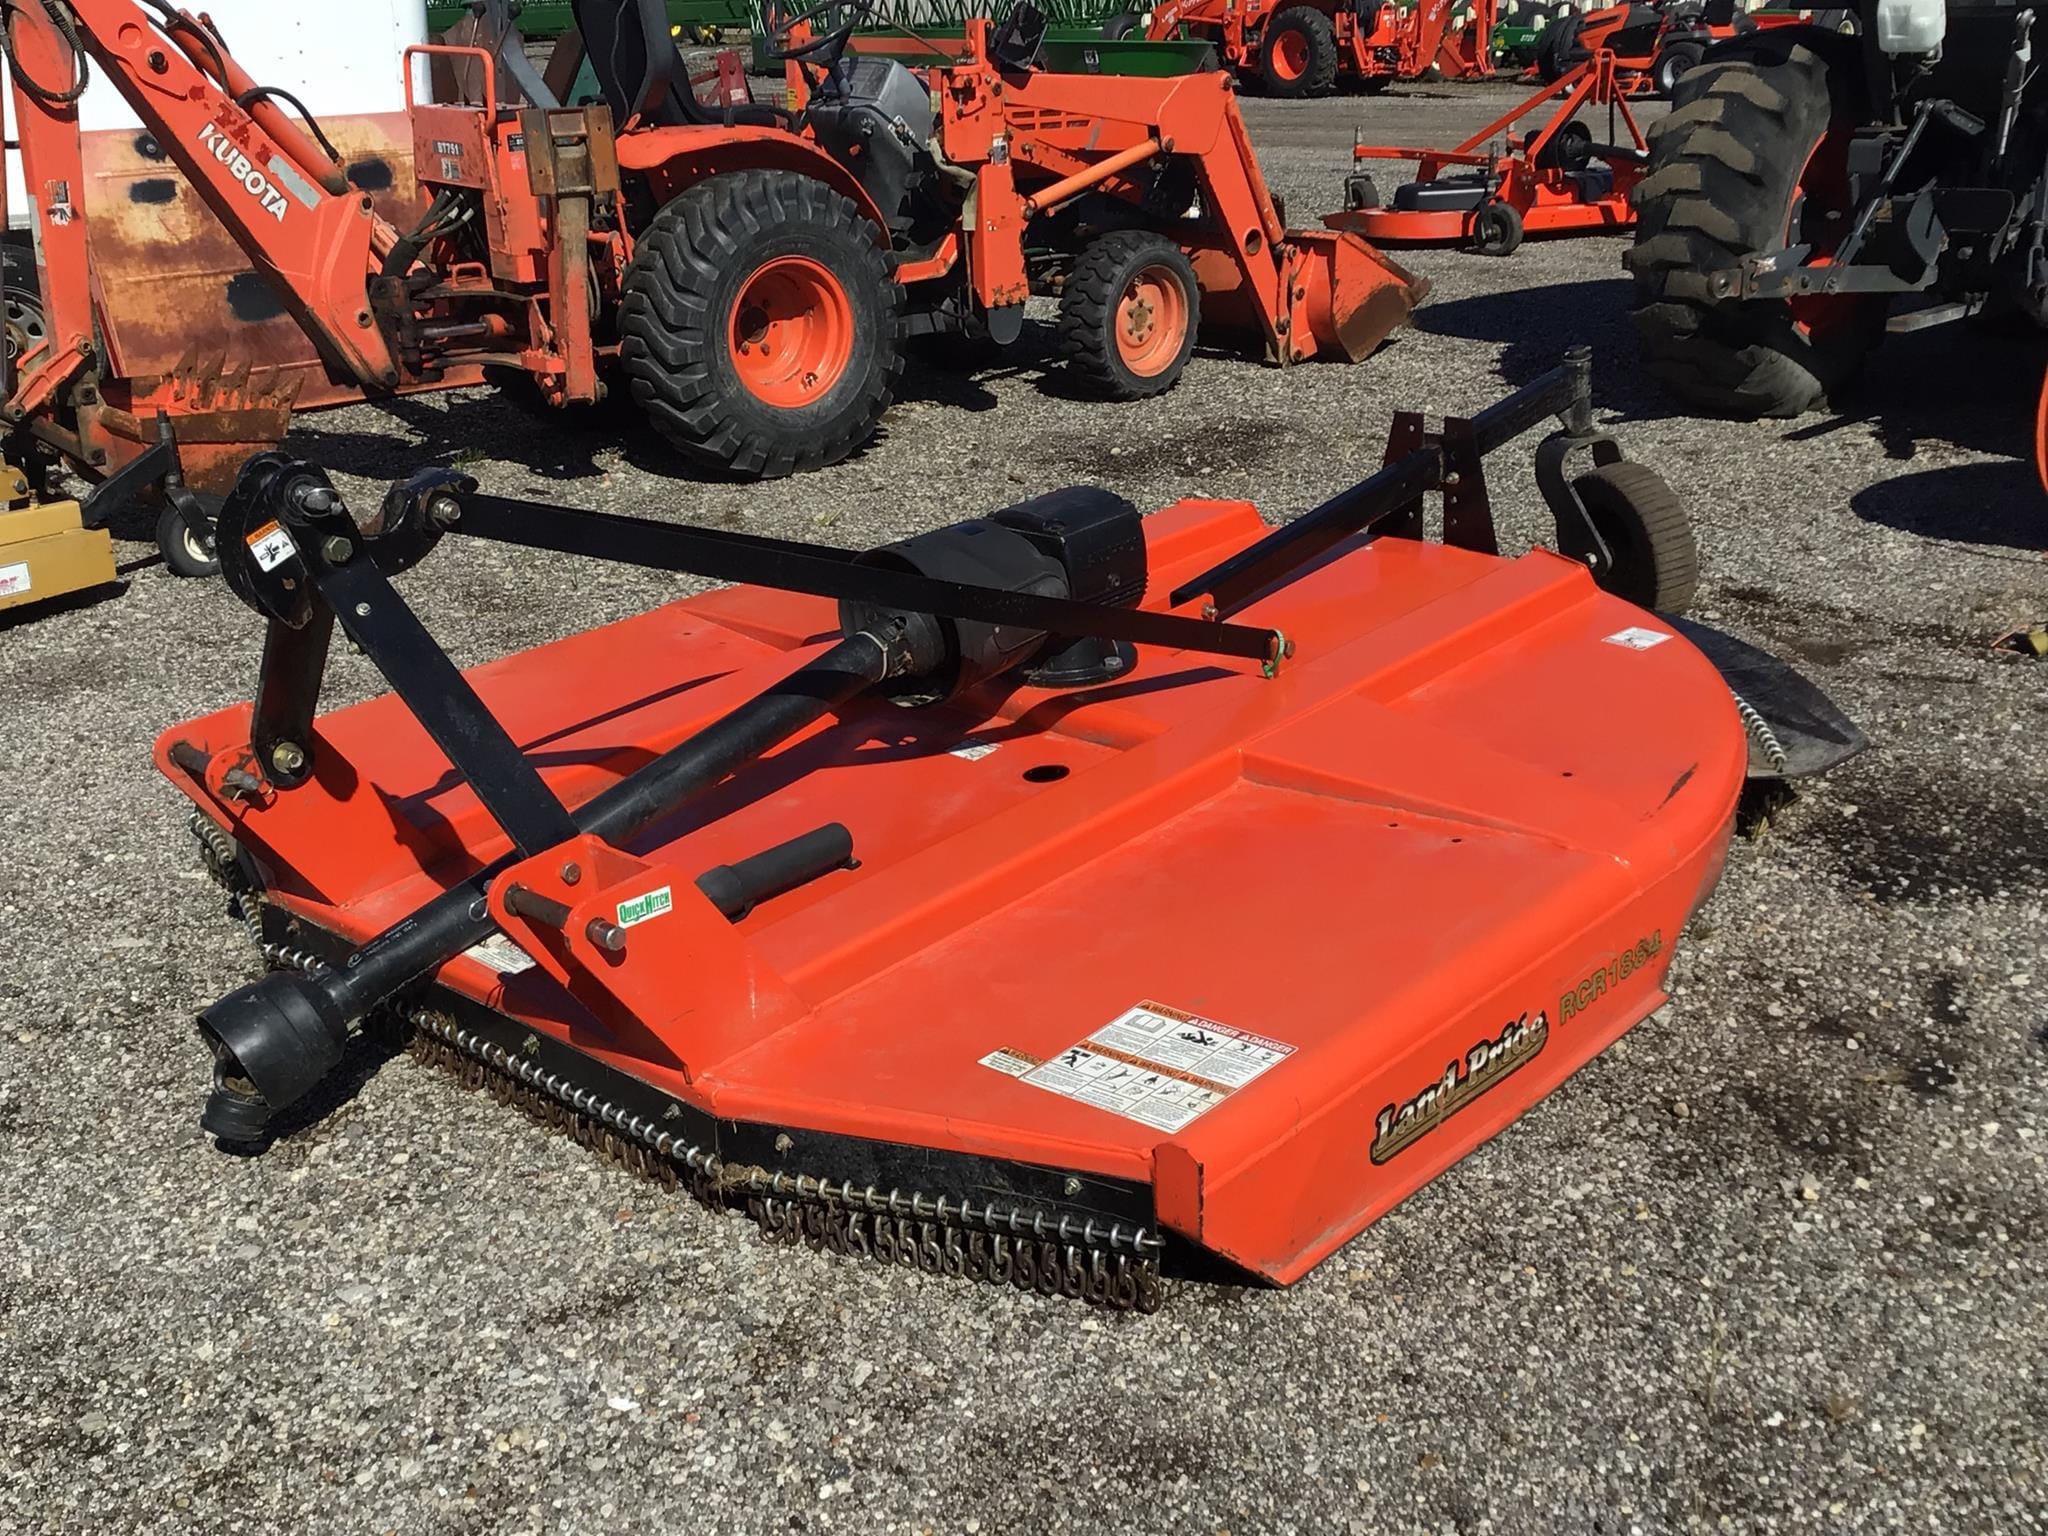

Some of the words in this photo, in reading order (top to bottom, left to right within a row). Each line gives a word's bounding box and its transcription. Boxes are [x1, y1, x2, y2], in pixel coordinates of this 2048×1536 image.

[197, 122, 289, 223] KUBOTA
[1196, 1020, 1240, 1036] DANGER
[1247, 1036, 1292, 1053] DANGER
[1376, 1060, 1459, 1150] Land
[1467, 1012, 1546, 1086] Pride
